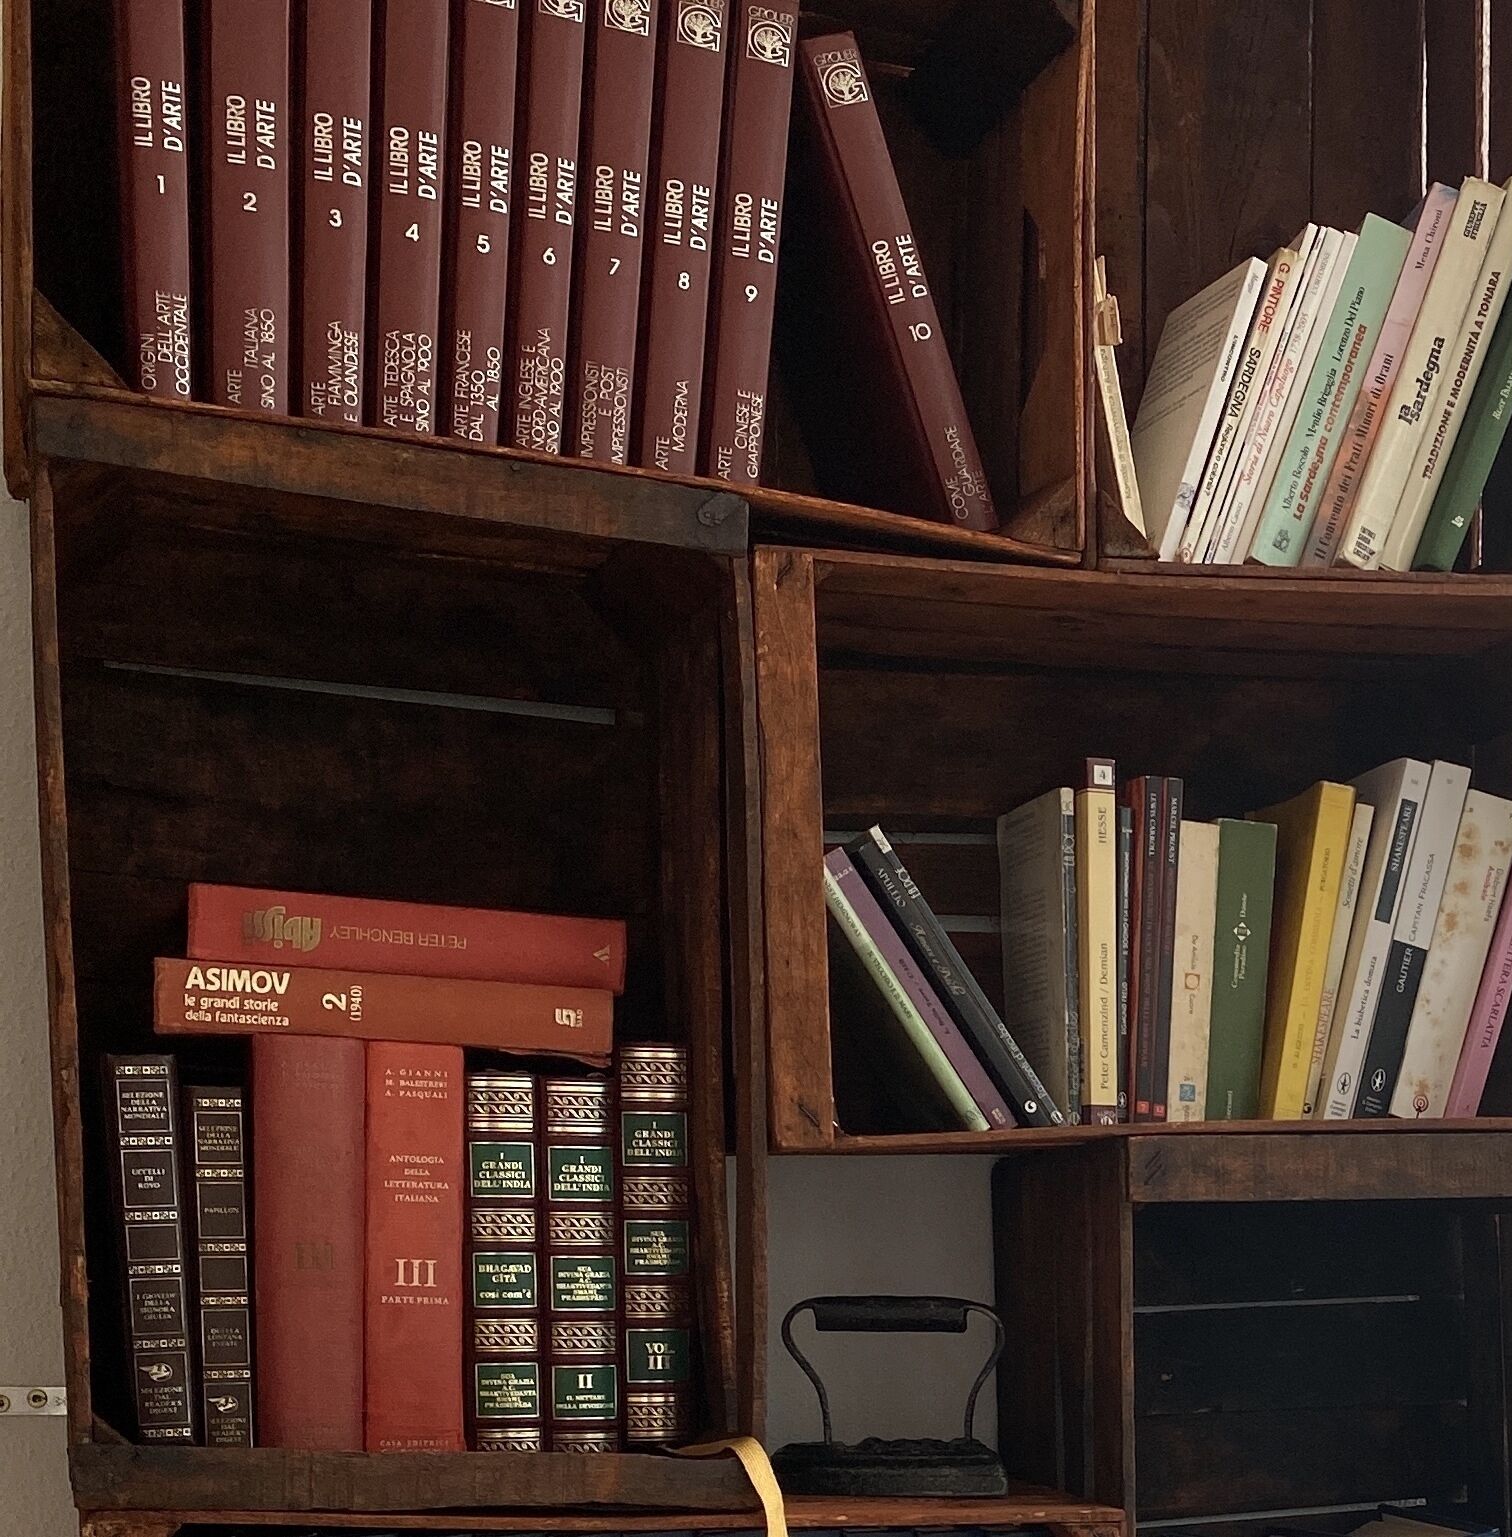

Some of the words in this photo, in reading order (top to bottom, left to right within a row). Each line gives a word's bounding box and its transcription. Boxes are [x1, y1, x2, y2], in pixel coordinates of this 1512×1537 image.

[131, 76, 152, 129] LIBRO
[162, 80, 183, 152] D'ARTE
[226, 95, 246, 147] LIBRO
[256, 99, 276, 170] D'ARTE
[134, 132, 153, 147] IL
[314, 112, 333, 164] LIBRO
[343, 117, 362, 187] D'ARTE
[389, 126, 409, 177] LIBRO
[227, 150, 246, 164] IL
[418, 130, 437, 200] D'ARTE
[462, 140, 482, 191] LIBRO
[157, 175, 165, 194] 1
[314, 166, 333, 182] IL
[389, 179, 408, 195] IL
[489, 145, 509, 214] D'ARTE
[528, 152, 549, 203] LIBRO
[243, 192, 257, 212] 2
[462, 193, 480, 208] IL
[555, 157, 575, 226] D'ARTE
[595, 165, 614, 215] LIBRO
[621, 169, 641, 238] D'ARTE
[664, 179, 684, 229] LIBRO
[329, 208, 342, 228] 3
[528, 204, 546, 219] IL
[594, 217, 612, 232] IL
[690, 184, 710, 251] D'ARTE
[733, 193, 753, 242] LIBRO
[405, 223, 419, 242] 4
[476, 234, 490, 254] 5
[664, 231, 682, 246] IL
[758, 197, 778, 264] D'ARTE
[1415, 247, 1431, 271] Mena
[1425, 209, 1443, 244] Chironi
[542, 247, 556, 265] 6
[609, 258, 620, 275] 7
[732, 244, 750, 258] IL
[872, 239, 900, 288] LIBRO
[895, 234, 928, 299] D'ARTE
[678, 271, 690, 290] 8
[745, 285, 758, 303] 9
[888, 287, 906, 305] IL
[1478, 271, 1501, 320] TONARA
[1258, 278, 1285, 335] PINTORE
[1350, 286, 1366, 311] Piano
[908, 322, 932, 342] 10
[1345, 310, 1357, 329] Del
[1474, 320, 1484, 331] A
[173, 293, 190, 395] OCCIDENTALE
[243, 307, 259, 369] ITALIANA
[1332, 327, 1351, 363] Lorenzo
[140, 333, 157, 390] ORIGINI
[327, 320, 342, 406] FIAMMINGA
[344, 330, 358, 407] OLANDESE
[1375, 353, 1394, 384] Orani
[1450, 330, 1481, 403] MODERNITÀ
[227, 369, 242, 404] ARTE
[737, 389, 750, 399] E
[1228, 346, 1262, 418] SARDEGNA
[1270, 359, 1294, 408] Capoluogo
[1317, 367, 1336, 407] Brigaglia
[1370, 383, 1382, 399] di
[1408, 336, 1446, 422] sardegna
[311, 381, 326, 416] ARTE
[1446, 399, 1456, 409] E
[344, 412, 358, 423] E
[672, 380, 689, 453] MODERNA
[735, 402, 750, 450] CINESE
[1260, 411, 1275, 440] Nuoro
[1293, 503, 1305, 521] La
[1324, 323, 1368, 432] contemporanea
[1355, 401, 1378, 441] Minori
[747, 393, 764, 479] GIAPPONESE
[1257, 442, 1265, 453] di
[1422, 413, 1450, 480] TRADIZIONE
[655, 436, 670, 471] ARTE
[718, 446, 733, 482] ARTE
[1292, 446, 1309, 479] Boscolo
[1344, 443, 1363, 472] Frati
[1242, 454, 1259, 485] Storia
[1340, 472, 1353, 495] dei
[1282, 481, 1299, 513] Alberto
[1319, 494, 1345, 547] Convento
[1098, 807, 1107, 844] HESSE
[1170, 797, 1178, 831] MARCEL
[1148, 818, 1156, 857] CARROLL
[1391, 806, 1413, 872] SHAKESPEARE
[1353, 836, 1364, 876] d'amore
[329, 925, 414, 946] BENCHLEY
[1396, 947, 1414, 993] GAUTIER
[1408, 901, 1424, 942] CAPITAN
[1418, 853, 1436, 899] FRACASSA
[418, 931, 468, 951] PETER
[1099, 942, 1109, 985] Demian
[185, 966, 290, 994] ASIMOV
[185, 993, 196, 1007] le
[200, 996, 240, 1009] grandi
[243, 998, 279, 1012] storie
[322, 992, 347, 1011] 2
[349, 985, 363, 1021] (1940)
[185, 1009, 212, 1022] della
[215, 1011, 290, 1026] fantascienza
[1100, 996, 1109, 1060] Camenzind
[1312, 987, 1335, 1065] SHAKESPEARE
[1481, 986, 1508, 1049] SCARLATTA
[1351, 1029, 1360, 1040] La
[1100, 1062, 1109, 1090] Peter
[121, 1105, 167, 1113] NARRATIVA
[124, 1112, 166, 1120] MONDIALE
[389, 1155, 445, 1165] ANTOLOGIA
[404, 1168, 430, 1176] DELLA
[479, 1170, 526, 1179] CLASSICI
[482, 1161, 523, 1170] GRANDI
[561, 1164, 602, 1173] GRANDI
[384, 1180, 449, 1190] LETTERATURA
[474, 1179, 531, 1189] DELL'INDIA
[553, 1182, 610, 1192] DELL'INDIA
[558, 1173, 605, 1182] CLASSICI
[204, 1206, 240, 1214] PAPILLON
[394, 1194, 440, 1203] ITALIANA
[394, 1258, 437, 1287] III
[478, 1264, 532, 1274] BHAGAVAD
[381, 1295, 416, 1305] PARTE
[417, 1295, 450, 1305] PRIMA
[576, 1373, 593, 1389] II
